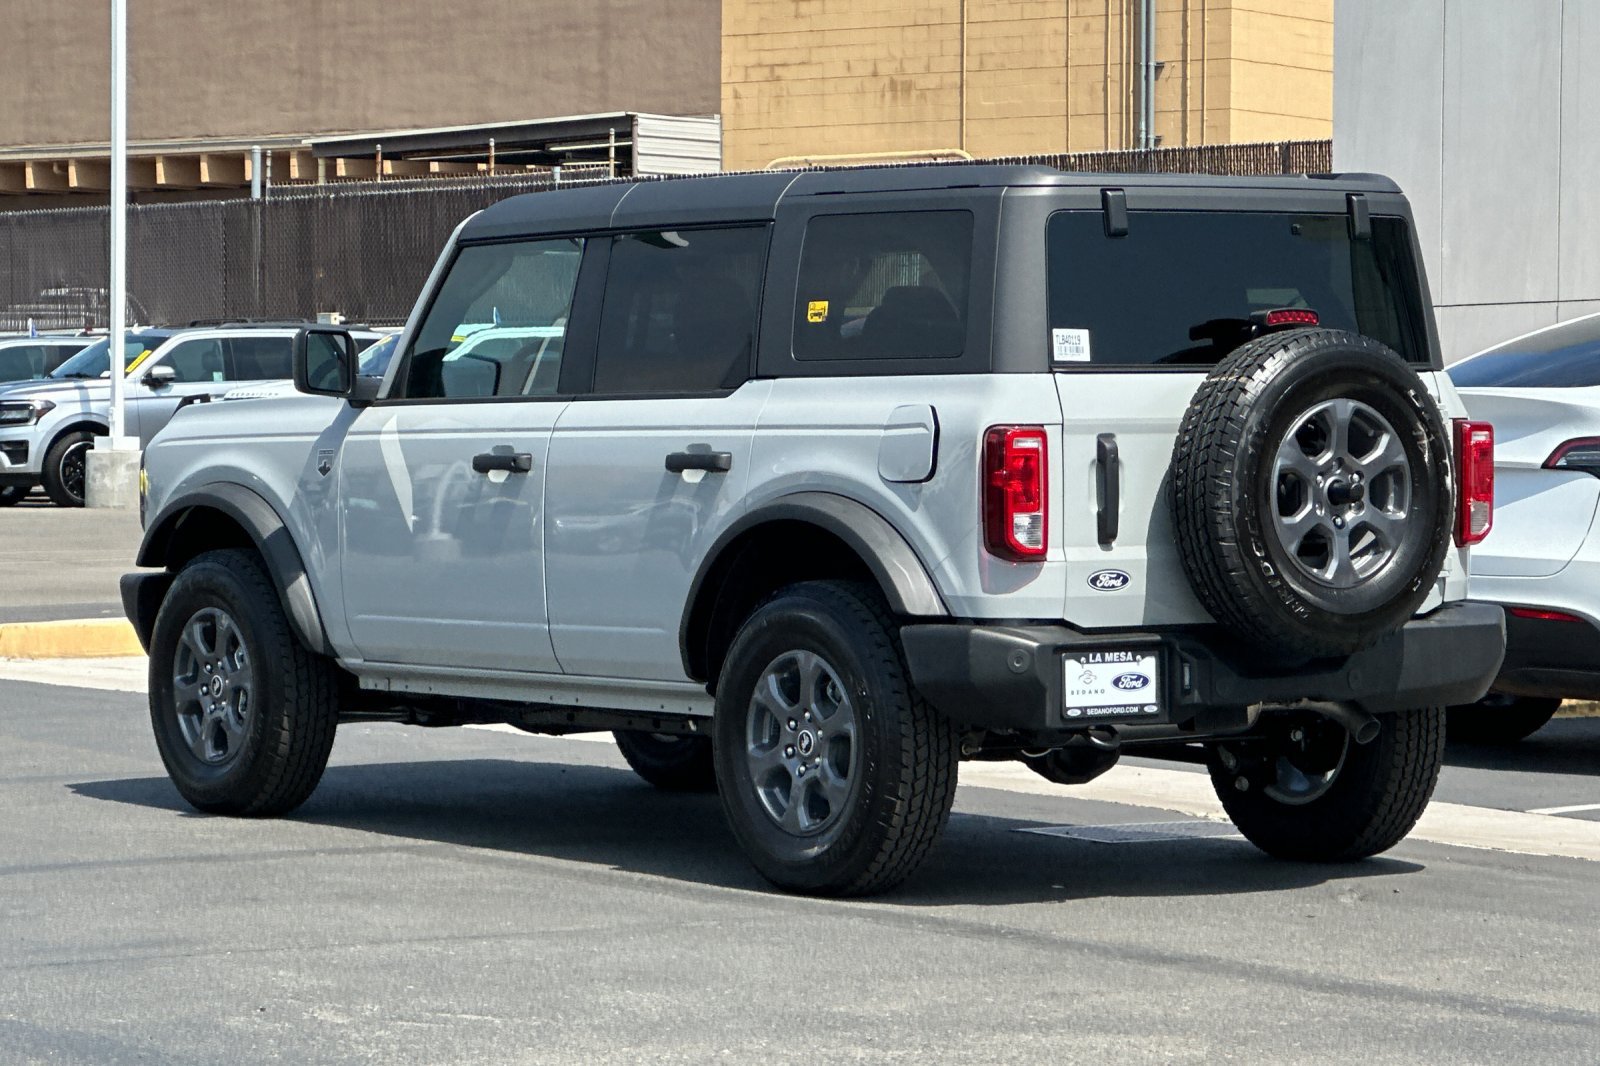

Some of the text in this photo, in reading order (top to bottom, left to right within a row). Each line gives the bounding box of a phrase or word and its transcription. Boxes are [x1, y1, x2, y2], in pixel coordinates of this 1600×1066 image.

[1096, 573, 1124, 587] Ford
[1089, 652, 1133, 663] LA MESA
[1118, 674, 1144, 689] Ford
[1071, 688, 1106, 696] SEDANO
[1086, 706, 1139, 716] SEDANOFORD.COM
